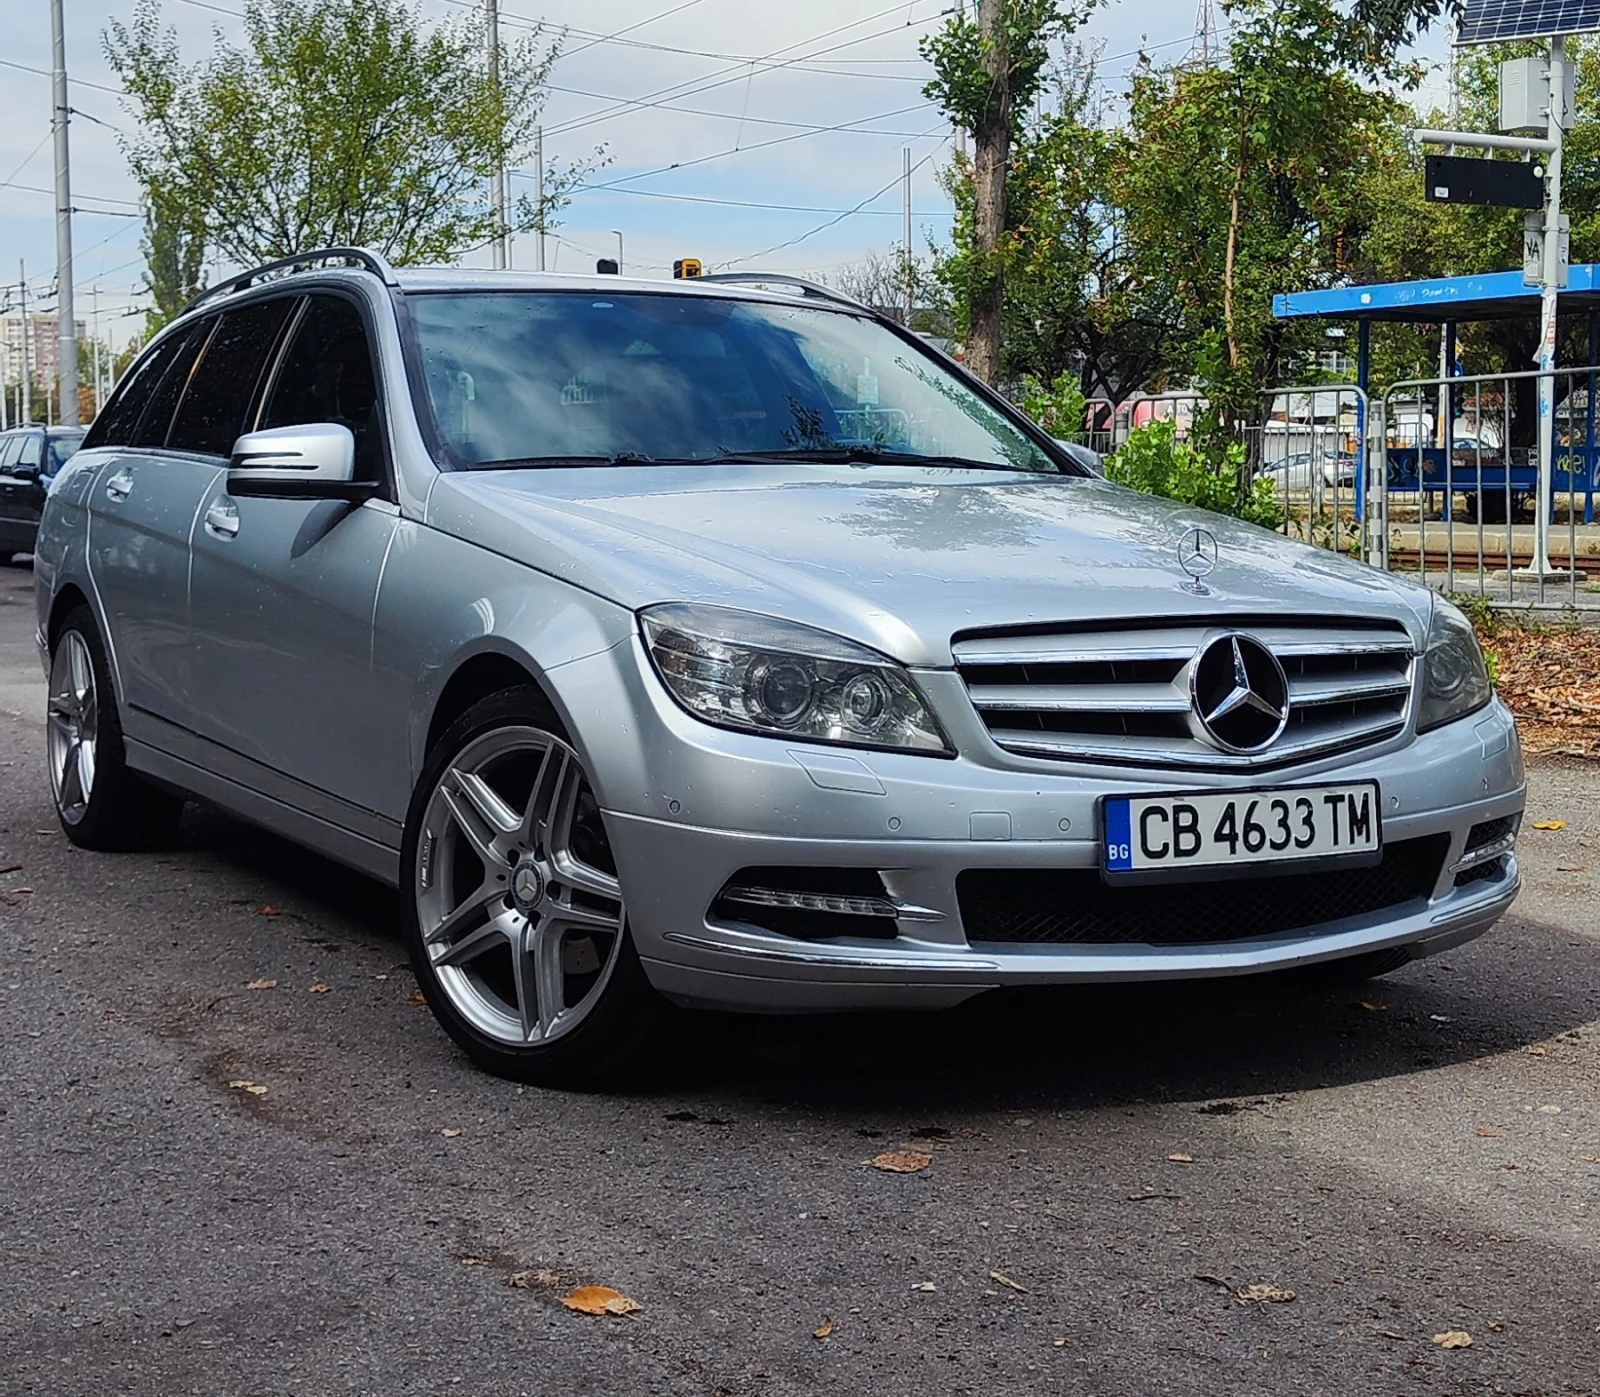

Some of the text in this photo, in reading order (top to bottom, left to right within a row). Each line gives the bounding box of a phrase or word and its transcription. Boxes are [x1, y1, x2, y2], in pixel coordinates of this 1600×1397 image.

[1140, 792, 1371, 860] CB 4633 TM
[1108, 844, 1129, 860] BG
